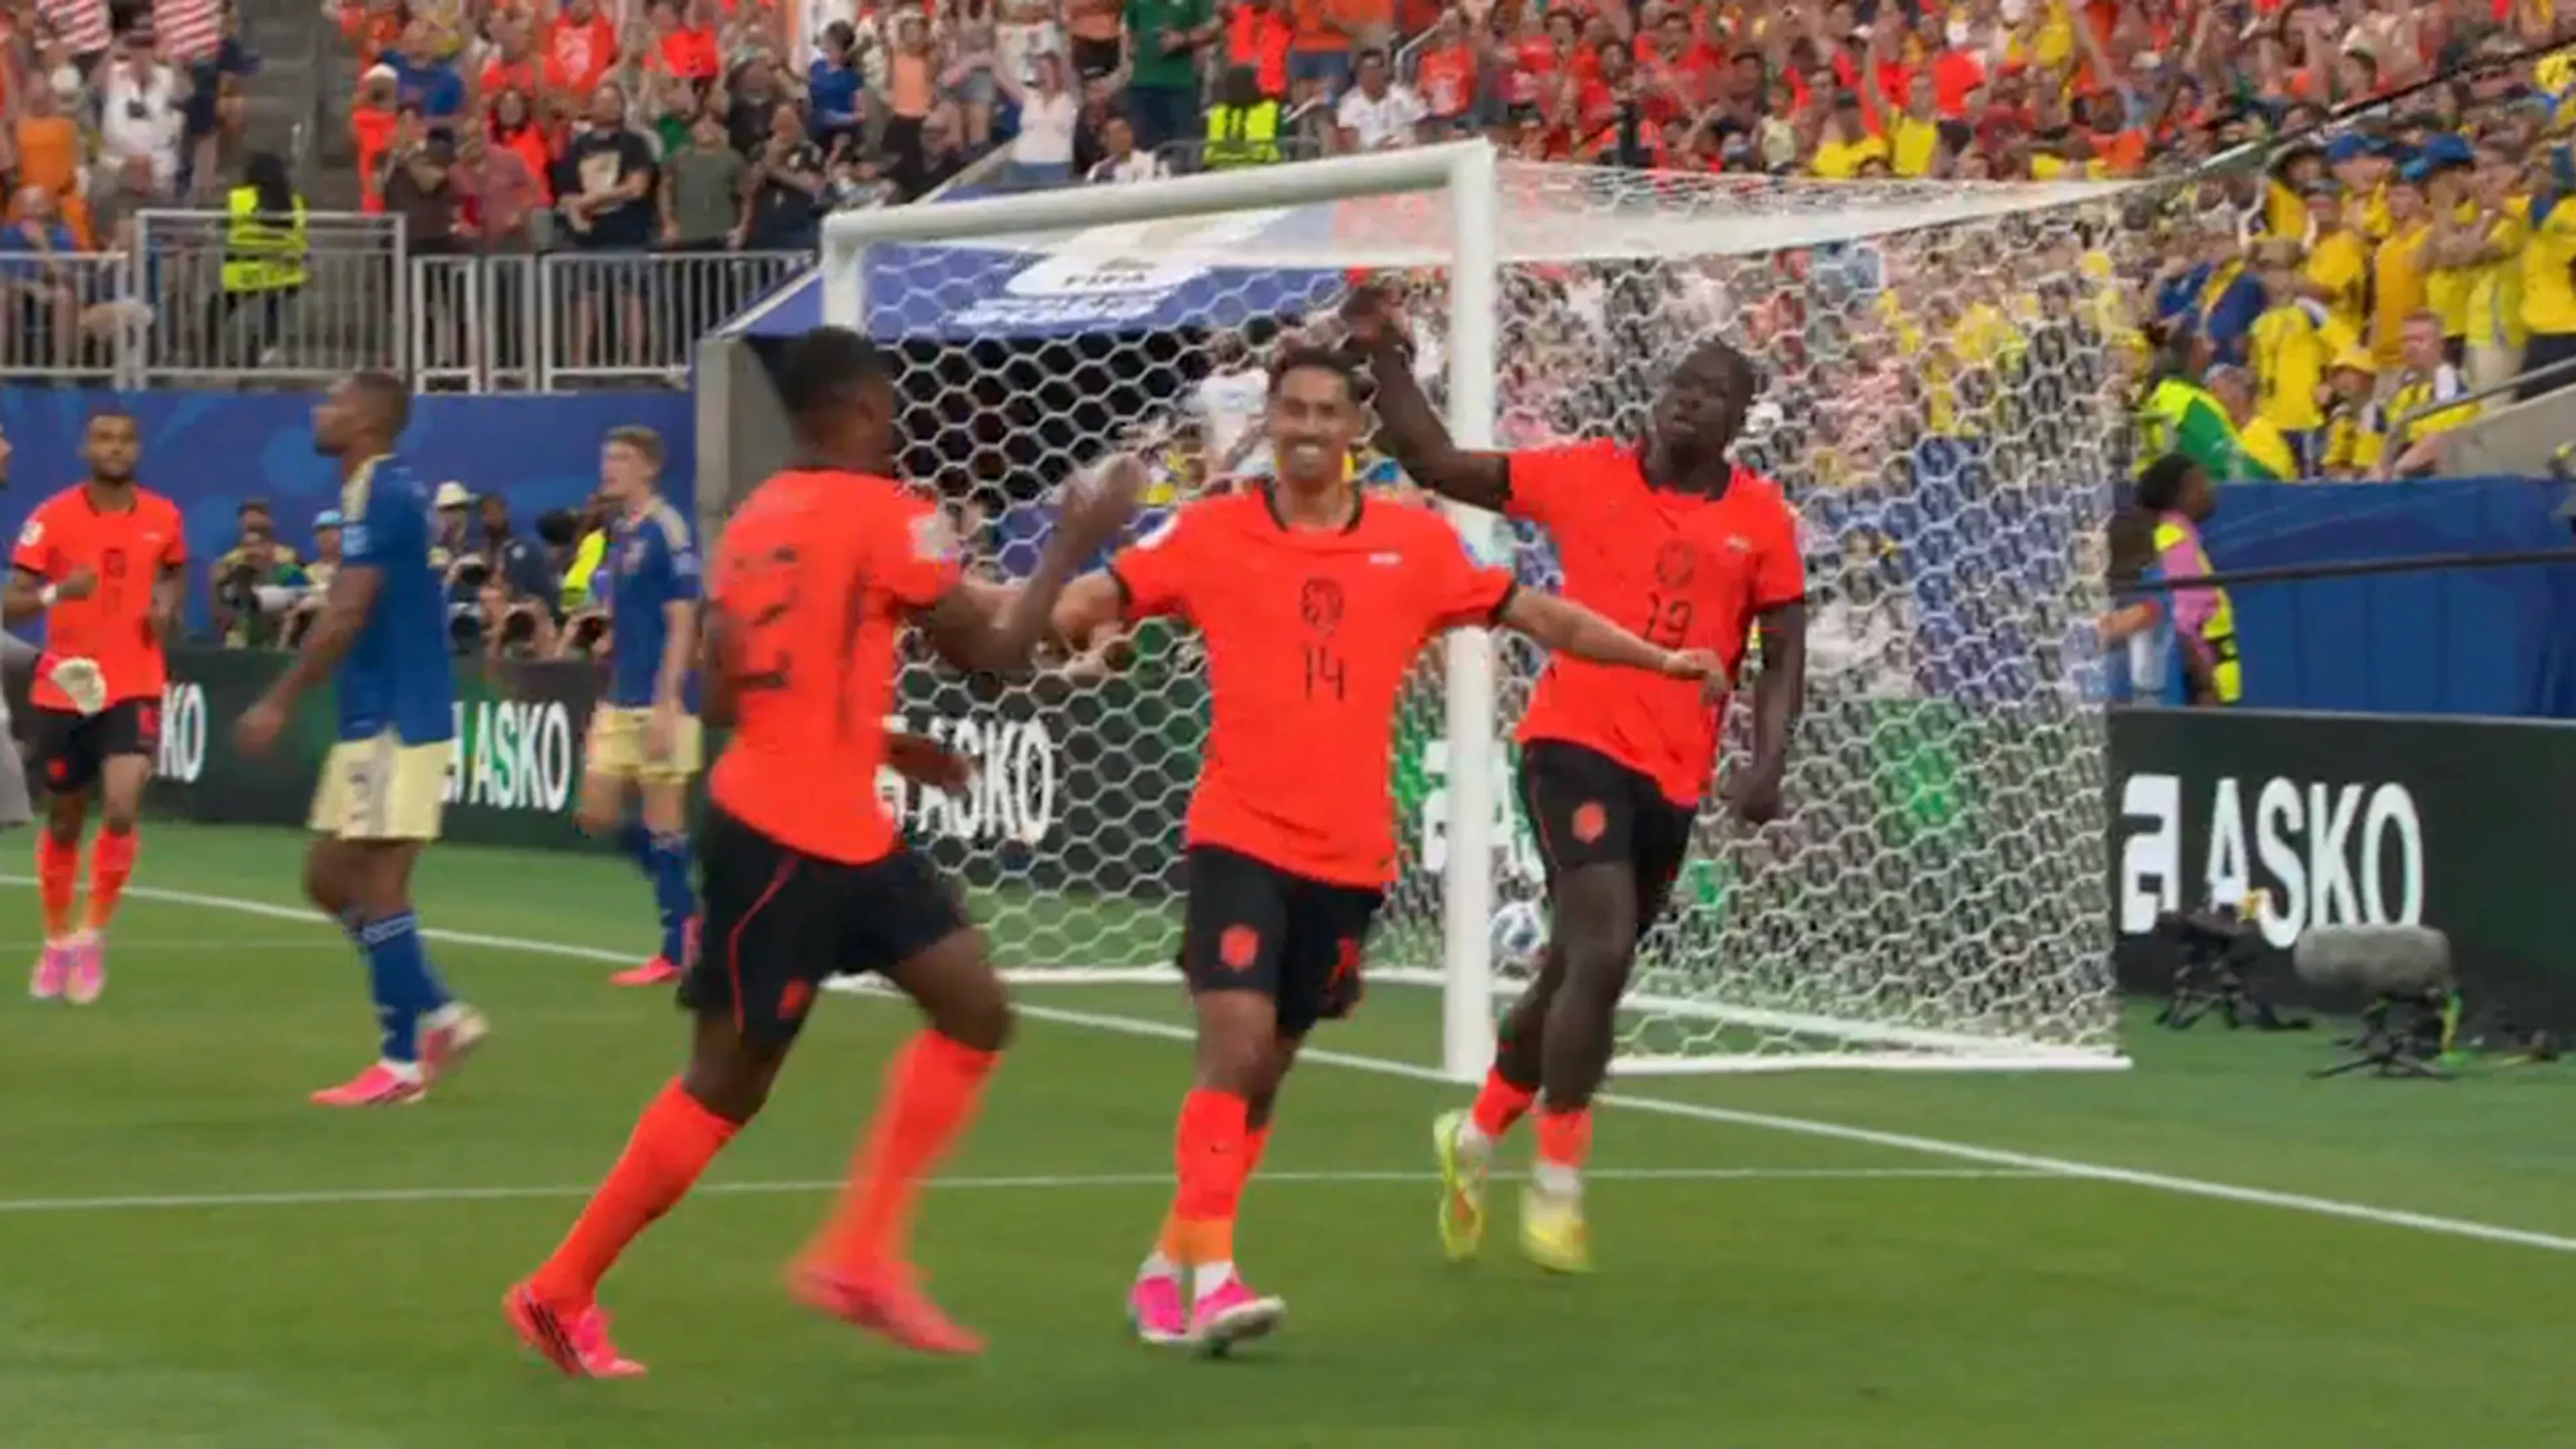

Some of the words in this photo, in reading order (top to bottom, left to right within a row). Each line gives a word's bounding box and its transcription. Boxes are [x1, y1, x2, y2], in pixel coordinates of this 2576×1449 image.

[1642, 590, 1692, 651] 19
[1297, 642, 1346, 702] 14
[470, 700, 571, 812] ASKO
[2207, 776, 2424, 949] ASKO
